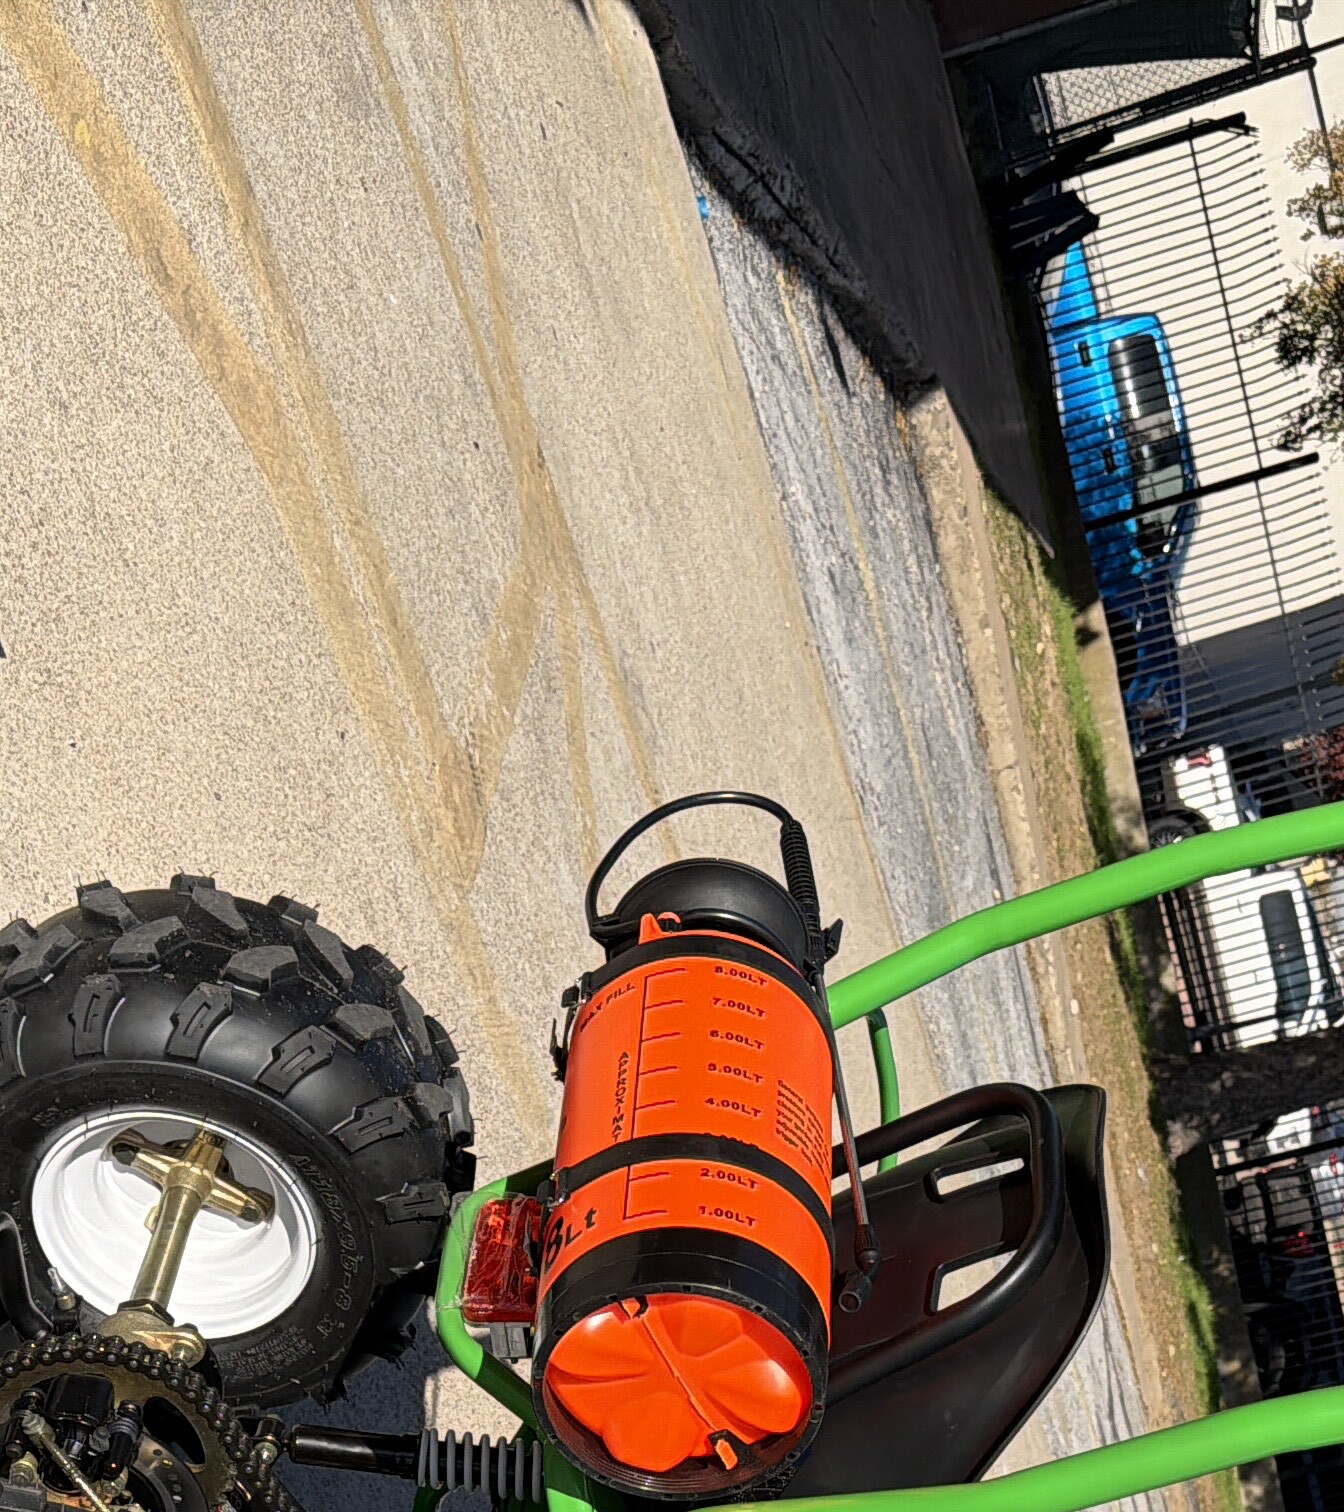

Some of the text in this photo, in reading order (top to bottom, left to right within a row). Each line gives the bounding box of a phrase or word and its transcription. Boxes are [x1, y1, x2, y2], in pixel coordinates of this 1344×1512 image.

[713, 965, 768, 987] 8.00LT
[606, 982, 636, 1005] FILL
[712, 996, 766, 1018] 7.00LT
[709, 1029, 764, 1050] 6.00LT
[707, 1062, 764, 1084] 5.00LT
[612, 1051, 630, 1143] APPROXIMAT
[704, 1097, 763, 1118] 4.00LT
[700, 1167, 758, 1189] 2.00LT
[698, 1205, 757, 1227] 1.00LT
